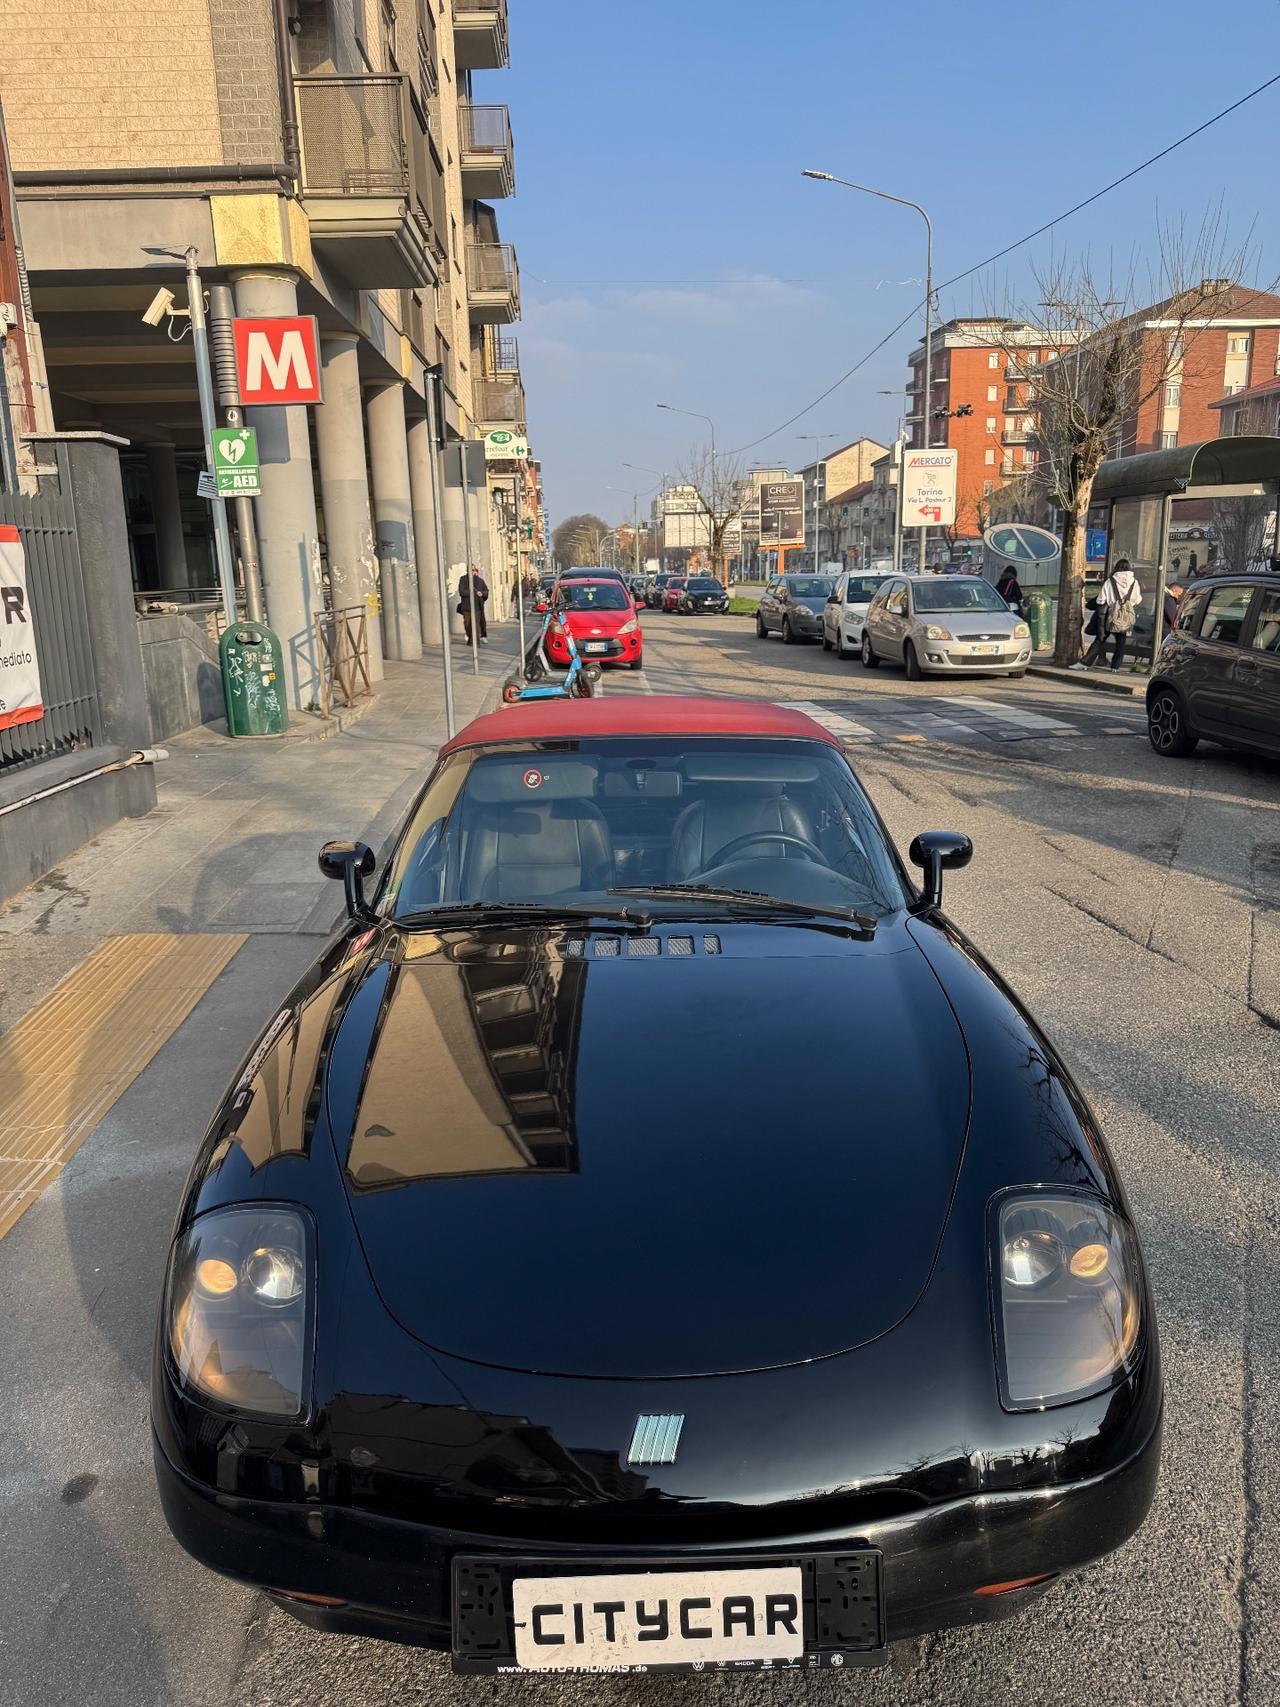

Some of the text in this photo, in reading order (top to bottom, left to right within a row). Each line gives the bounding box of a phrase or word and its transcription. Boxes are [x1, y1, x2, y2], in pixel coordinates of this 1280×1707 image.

[245, 331, 314, 391] M
[233, 475, 257, 488] AED
[917, 488, 943, 496] Torino
[532, 1593, 799, 1646] CITYCAR
